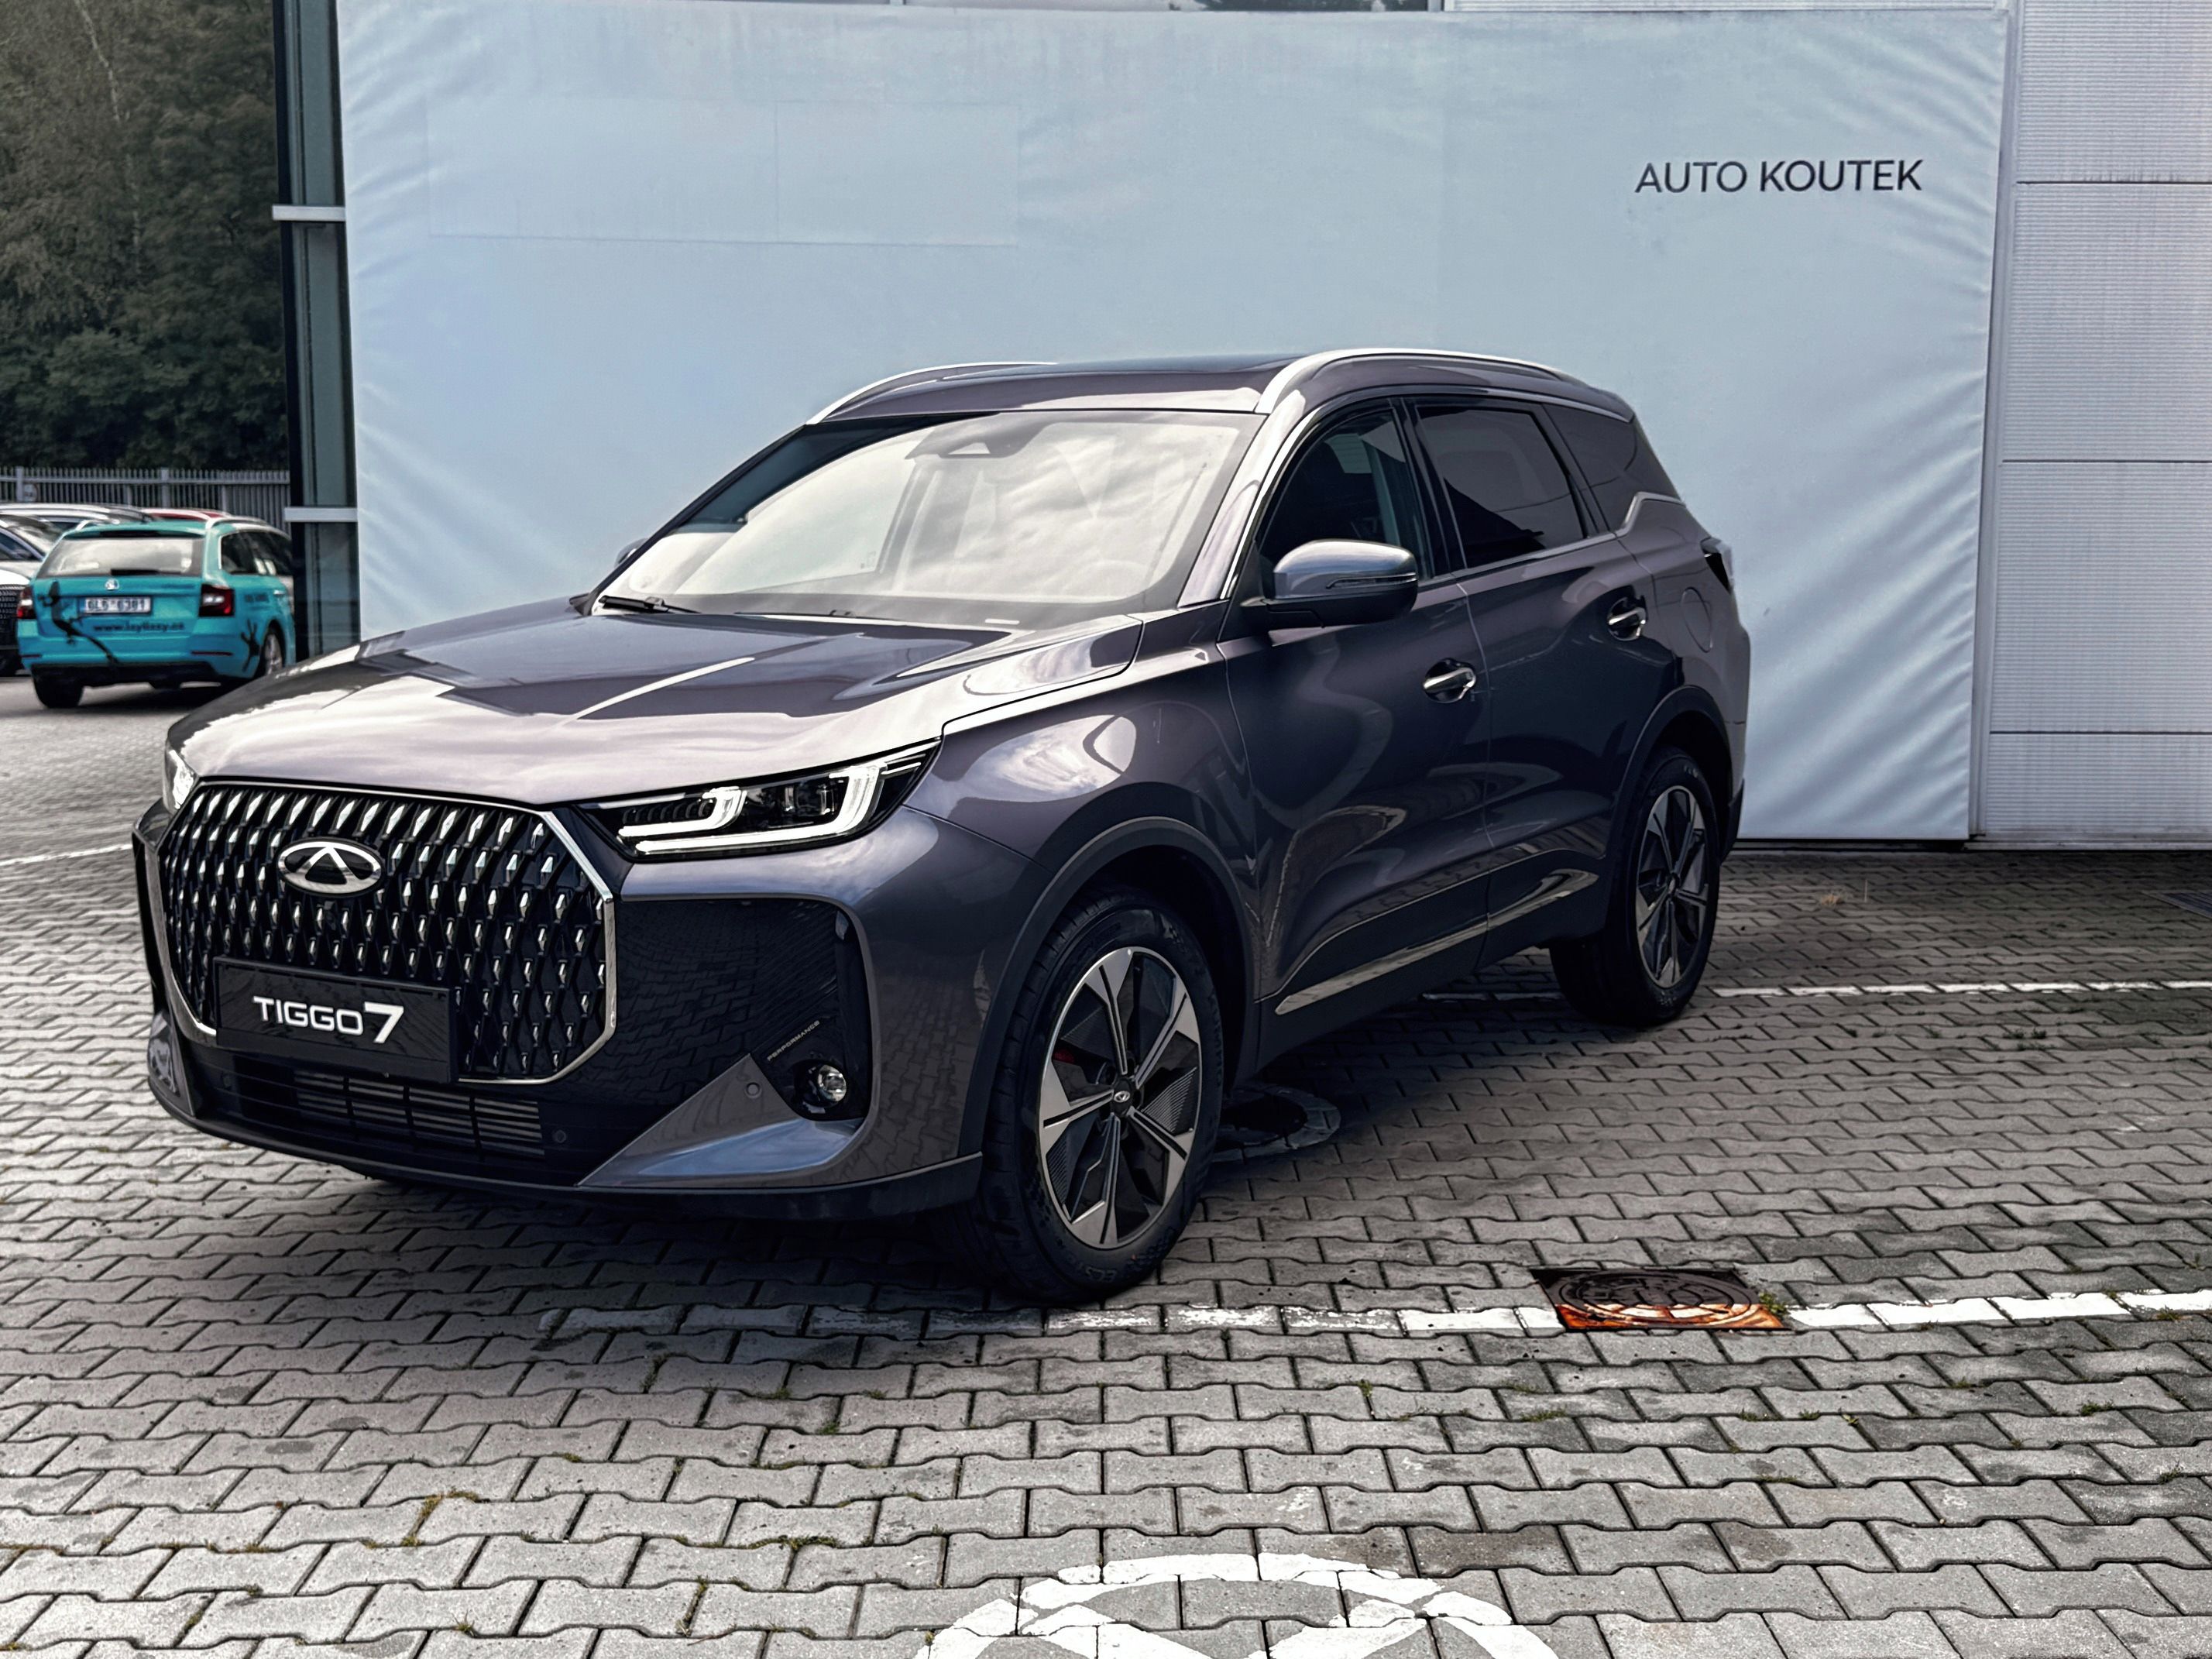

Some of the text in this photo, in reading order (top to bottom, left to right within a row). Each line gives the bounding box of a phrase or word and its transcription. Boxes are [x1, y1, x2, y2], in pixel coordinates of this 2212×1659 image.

[1635, 160, 1923, 193] AUTO KOUTEK
[767, 1020, 819, 1061] PERFORMANCE
